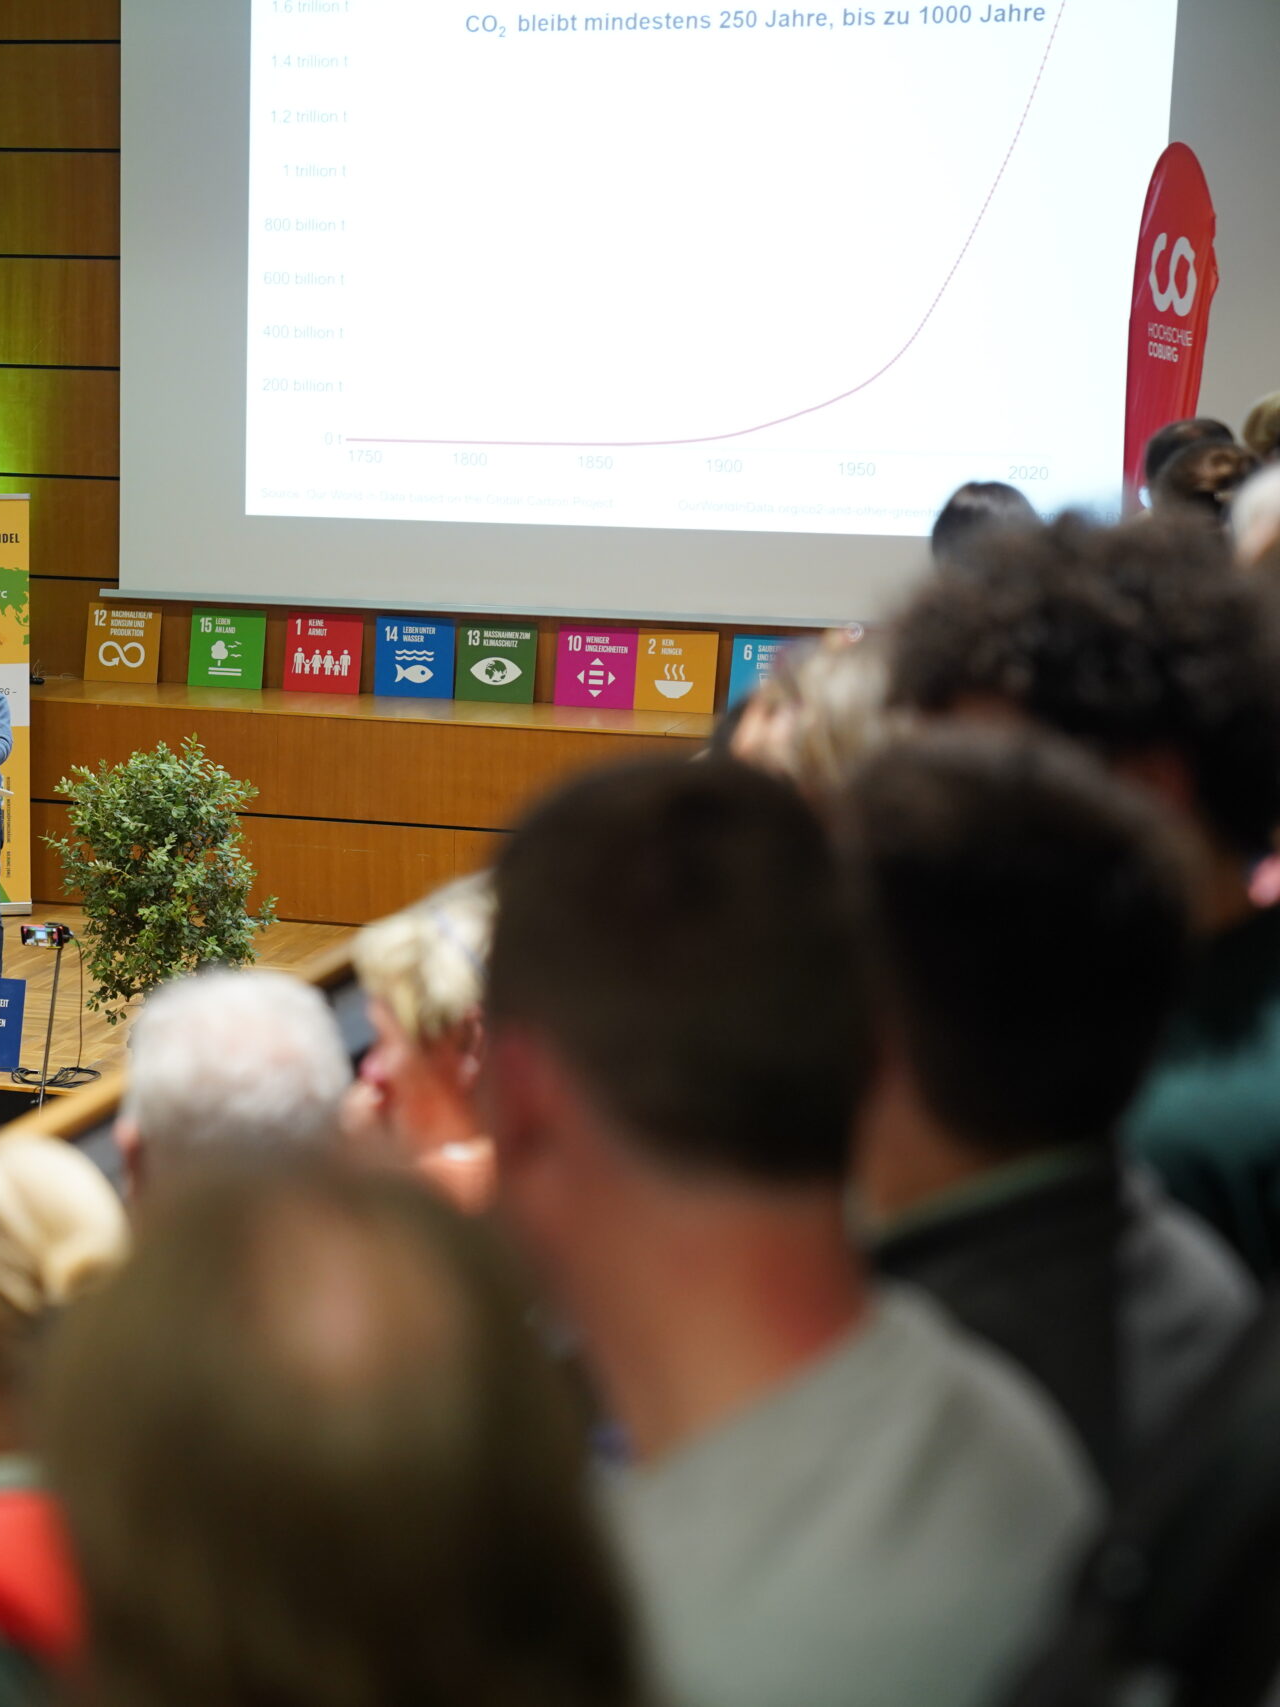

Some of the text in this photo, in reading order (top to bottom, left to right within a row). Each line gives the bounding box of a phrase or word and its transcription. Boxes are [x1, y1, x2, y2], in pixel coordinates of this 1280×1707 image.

[298, 0, 340, 13] trillion
[517, 14, 577, 32] bleibt
[584, 12, 711, 32] mindestens
[719, 9, 757, 29] 250
[765, 9, 835, 30] Jahre,
[842, 7, 875, 27] bis
[883, 10, 909, 25] zu
[919, 4, 971, 24] 1000
[980, 3, 1046, 23] Jahre
[297, 55, 339, 68] trillion
[296, 110, 338, 123] trillion
[295, 164, 337, 177] trillion
[264, 218, 291, 232] 800
[295, 218, 336, 232] billion
[263, 271, 290, 285] 600
[295, 272, 335, 285] billion
[262, 325, 289, 338] 400
[294, 325, 335, 339] billion
[262, 378, 289, 391] 200
[293, 378, 333, 392] billion
[347, 449, 383, 464] 1750
[451, 452, 488, 467] 1800
[577, 455, 613, 470] 1850
[705, 458, 743, 474] 1900
[838, 461, 877, 477] 1950
[1007, 465, 1050, 480] 2020
[94, 609, 107, 626] 12
[110, 619, 145, 628] KONSUM UND
[199, 616, 213, 633] 15
[215, 617, 231, 626] LEBEN
[308, 619, 325, 628] KEINE
[110, 628, 144, 637] PRODUKTION
[214, 625, 236, 634] AN LAND
[295, 618, 302, 636] 1
[307, 627, 328, 637] ARMUT
[384, 625, 399, 642] 14
[403, 626, 436, 635] LEBEN UNTER
[403, 634, 425, 643] WASSER
[467, 629, 480, 646] 13
[483, 630, 531, 640] MASSNAHMEN ZUM
[585, 635, 610, 644] WENIGER
[483, 639, 519, 648] KLIMASCHUTZ
[567, 634, 582, 652] 10
[585, 644, 629, 654] UNGLEICHHEITEN
[647, 638, 657, 655] 2
[661, 639, 674, 647] KEIN
[661, 647, 683, 656] HUNGER
[743, 644, 753, 661] 6
